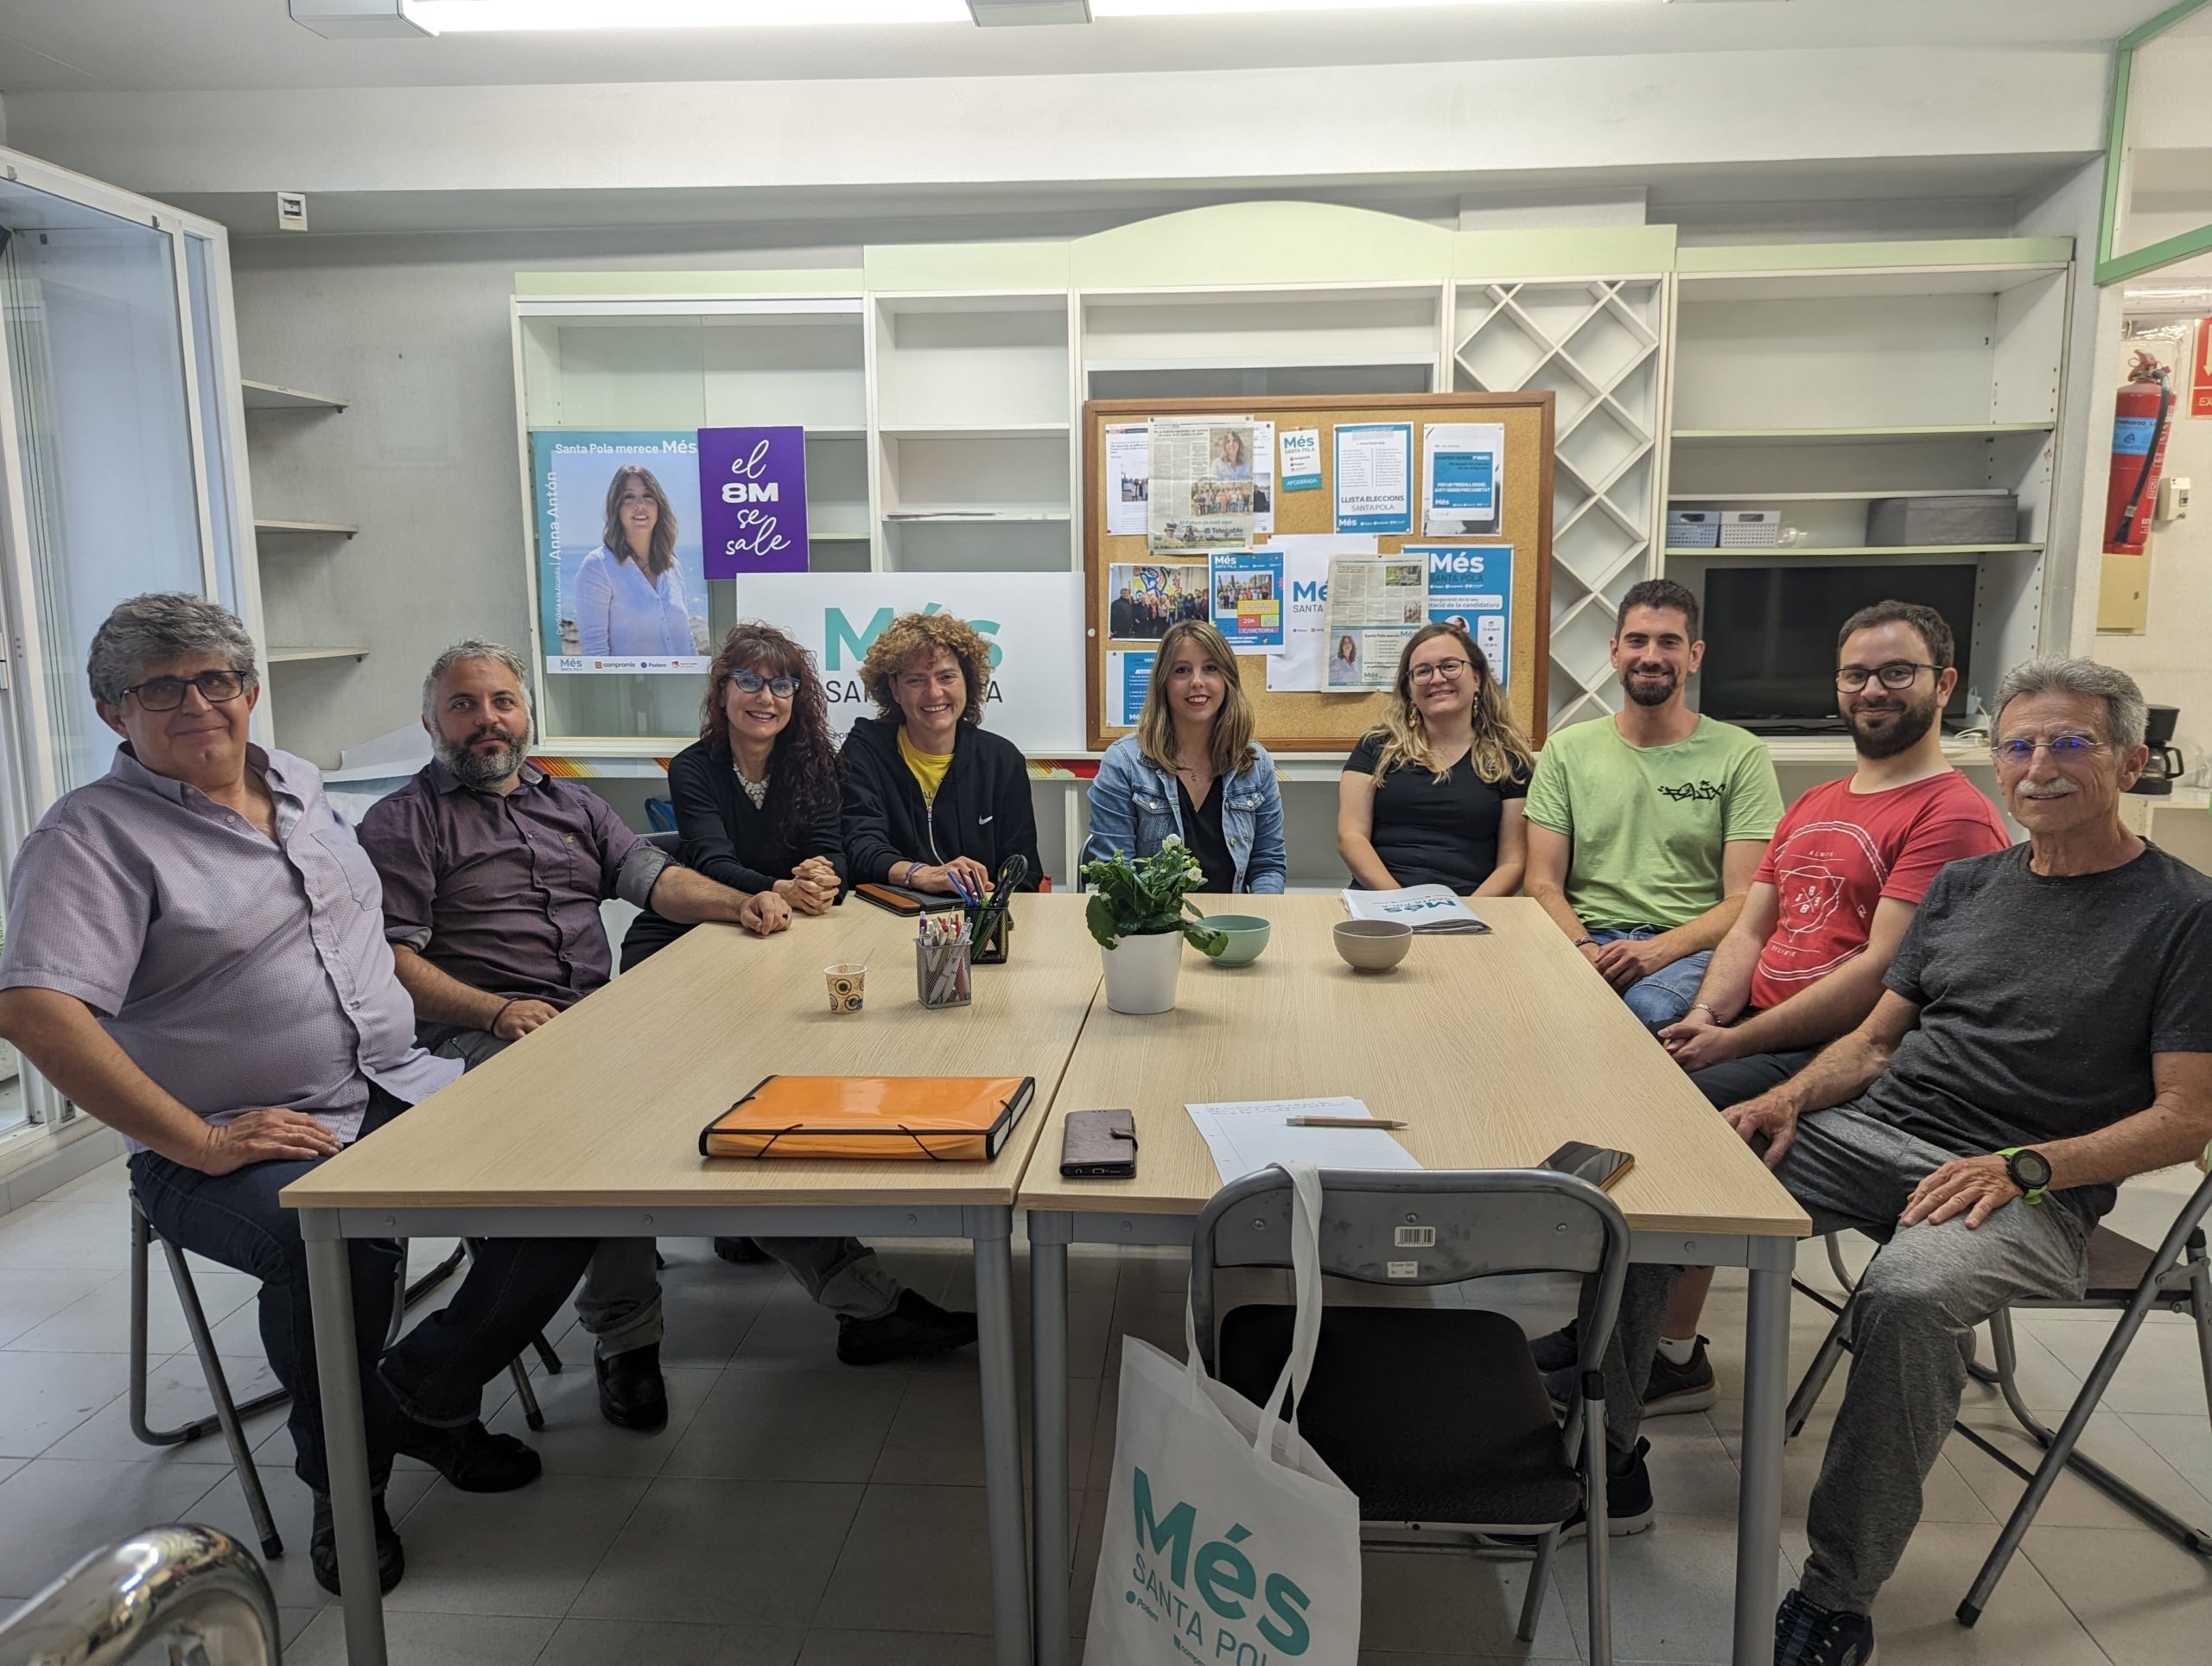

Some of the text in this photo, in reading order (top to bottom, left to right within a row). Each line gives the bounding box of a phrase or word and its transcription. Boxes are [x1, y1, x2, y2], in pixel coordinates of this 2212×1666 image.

[555, 440, 698, 455] Santa Pola merece Més
[1284, 436, 1314, 448] Més
[732, 439, 769, 479] el
[722, 482, 779, 503] 8M
[544, 472, 562, 560] Anna Antón
[737, 509, 768, 529] se
[1338, 518, 1357, 526] Més
[726, 517, 791, 556] sale
[1214, 556, 1237, 565] Més
[1430, 551, 1484, 573] Més
[1430, 574, 1484, 582] SANTA POLA
[1293, 604, 1324, 614] SANTA
[560, 658, 582, 667] Més
[1383, 900, 1457, 913] Més
[1133, 1466, 1312, 1656] Més
[1133, 1552, 1203, 1646] SANTA
[1136, 1598, 1158, 1622] Podem
